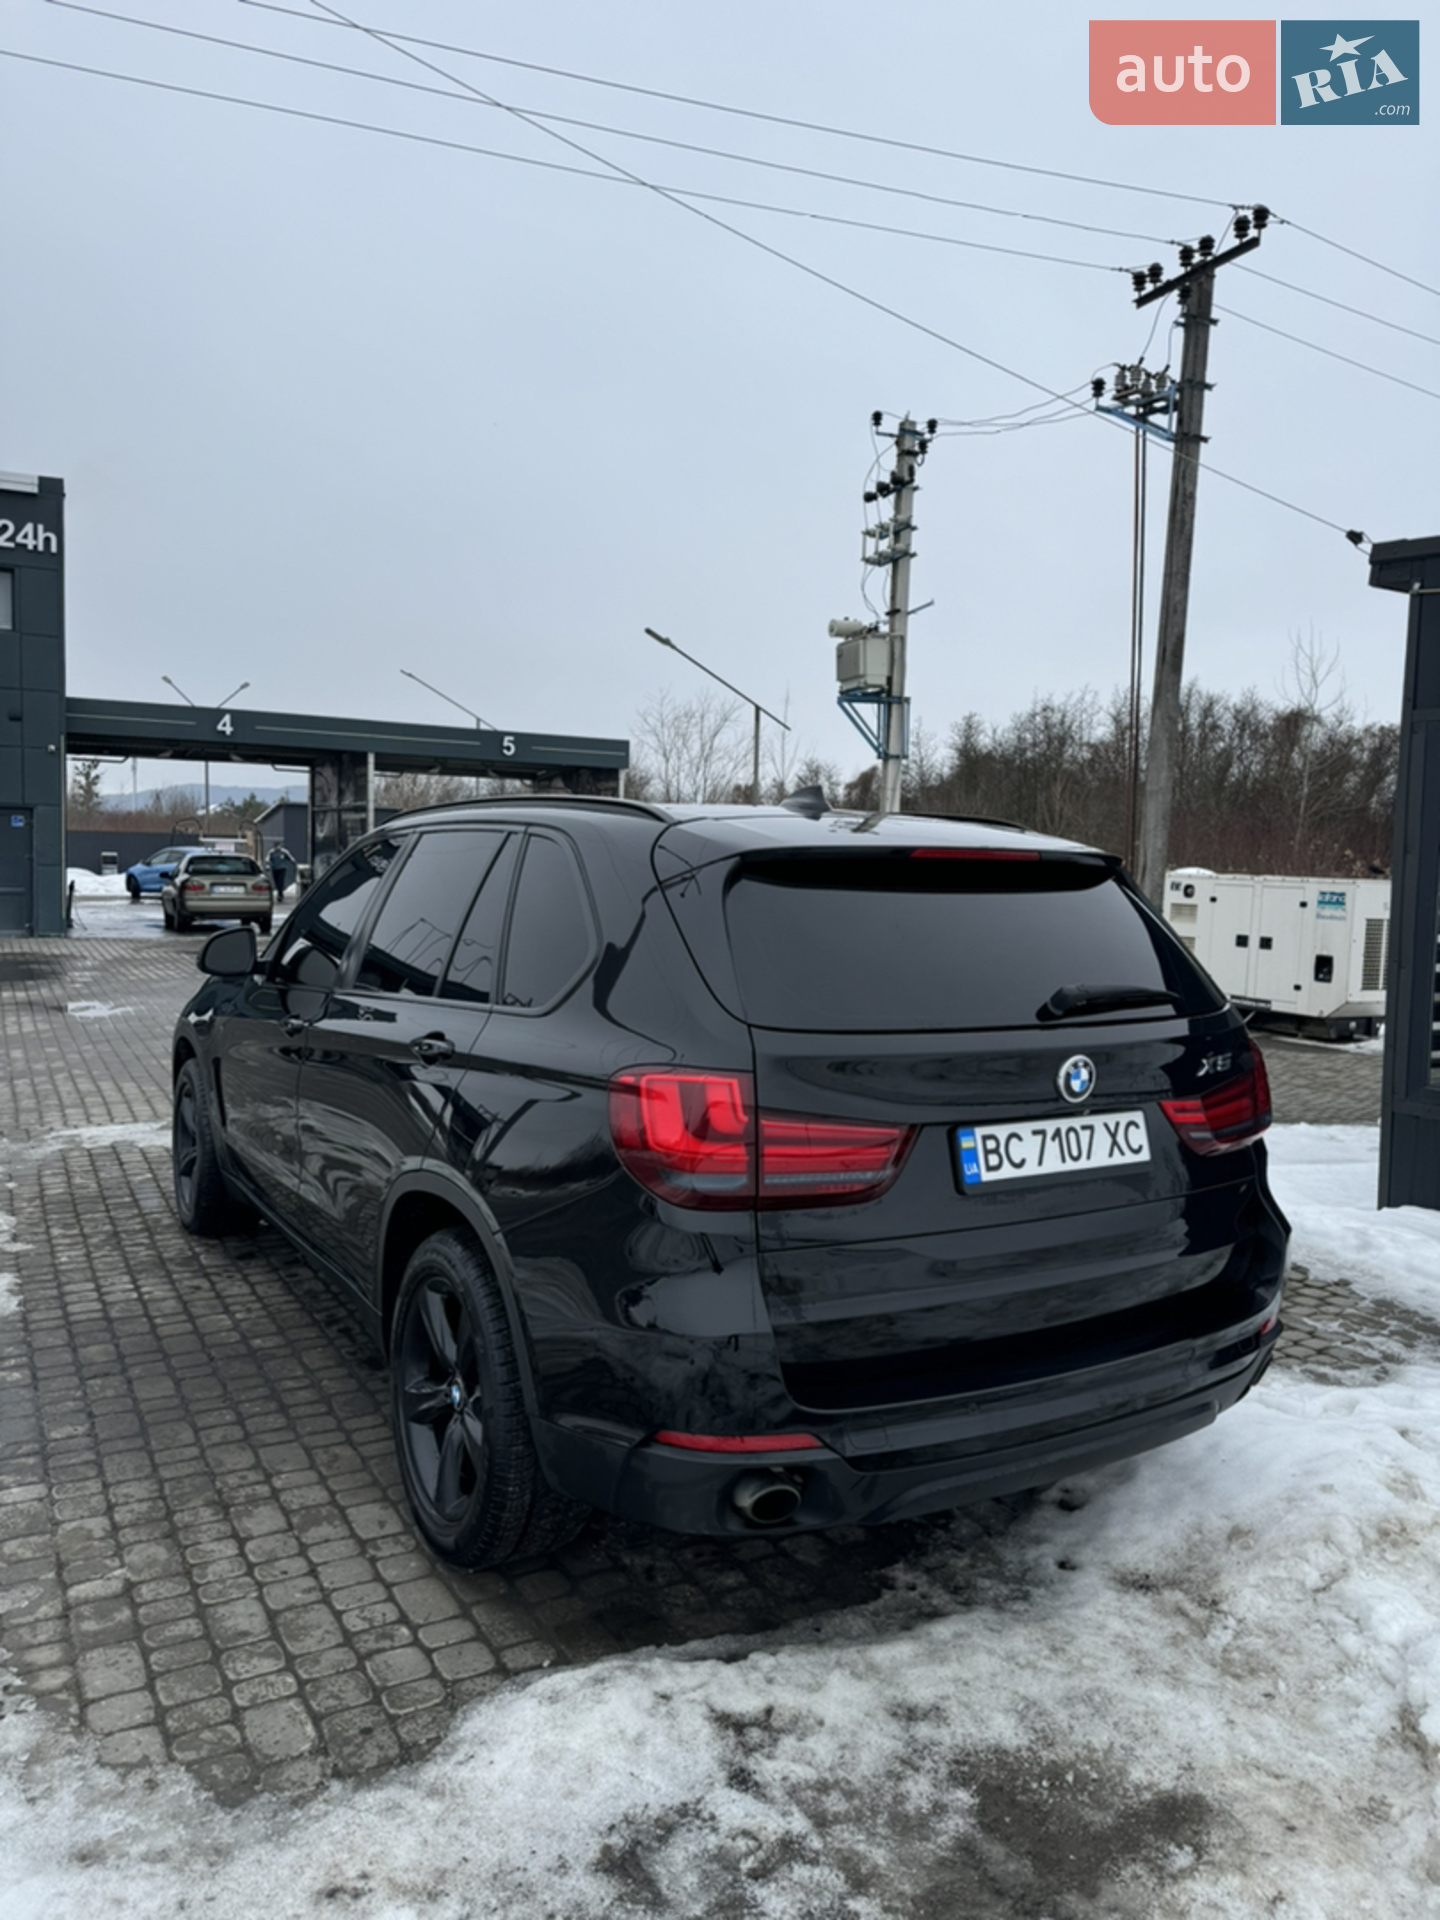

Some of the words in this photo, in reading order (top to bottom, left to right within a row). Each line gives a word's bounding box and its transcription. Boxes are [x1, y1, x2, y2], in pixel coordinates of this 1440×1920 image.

[0, 518, 58, 554] 24h
[216, 713, 234, 735] 4
[502, 735, 516, 756] 5
[981, 1132, 1027, 1173] BC
[1031, 1124, 1095, 1168] 7107
[1103, 1120, 1144, 1159] XC
[963, 1163, 980, 1176] UA
